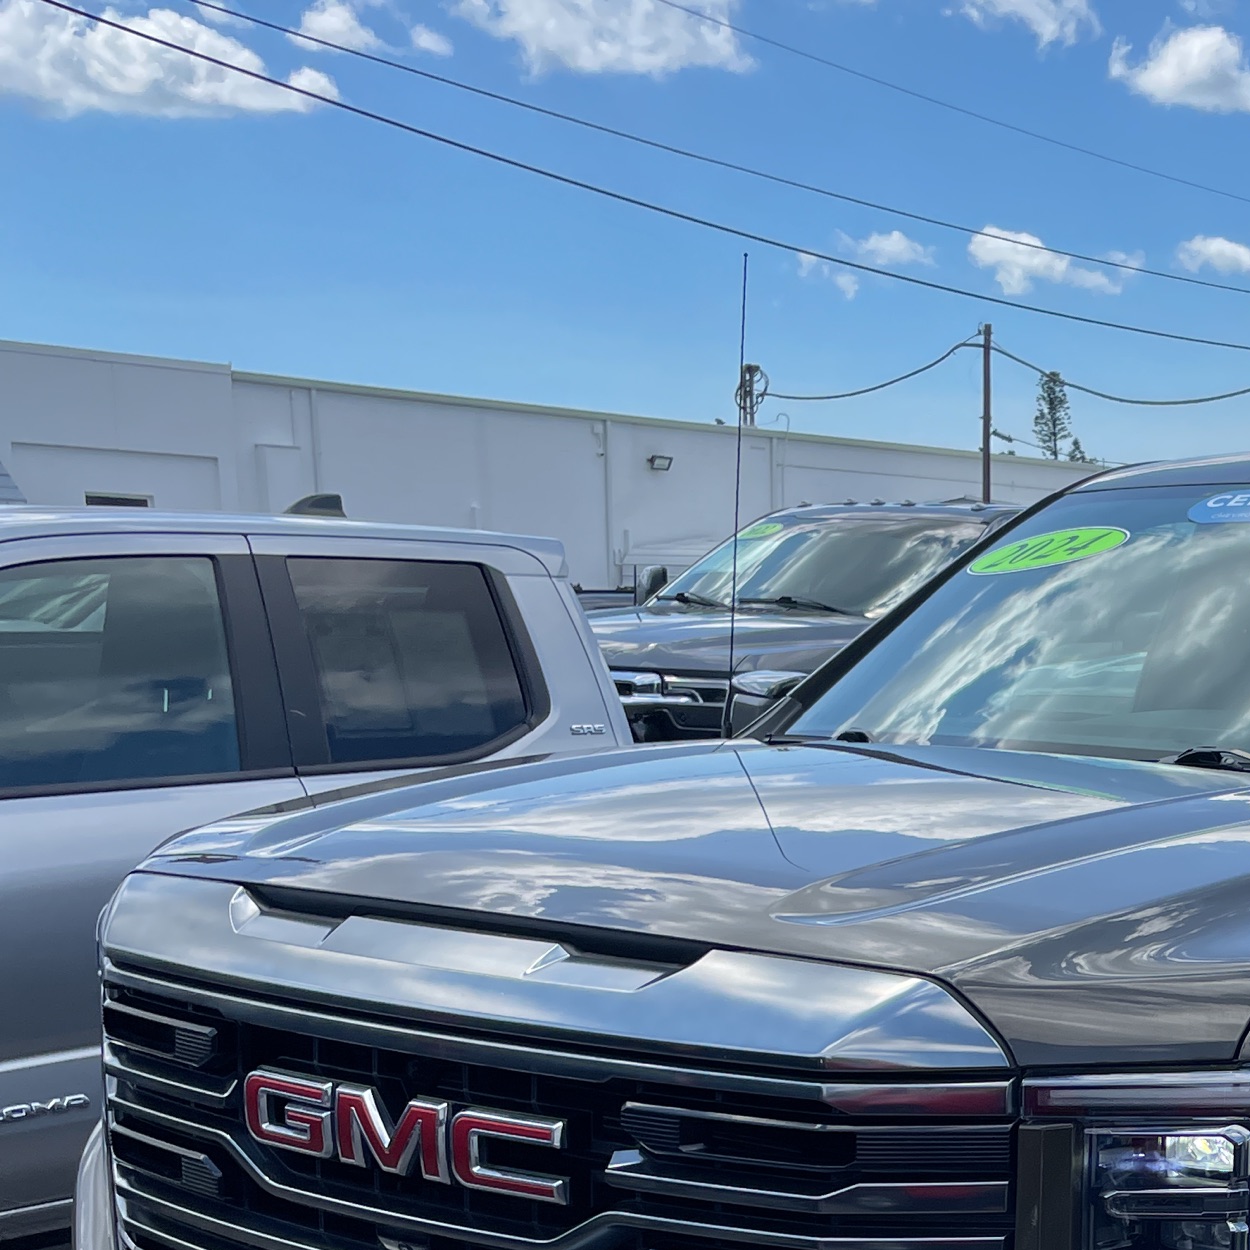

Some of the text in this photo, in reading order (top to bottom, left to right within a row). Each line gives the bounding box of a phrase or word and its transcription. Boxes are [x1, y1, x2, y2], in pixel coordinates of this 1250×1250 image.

[981, 530, 1114, 571] 2024
[0, 1093, 90, 1121] OMA
[244, 1065, 570, 1206] GMC
